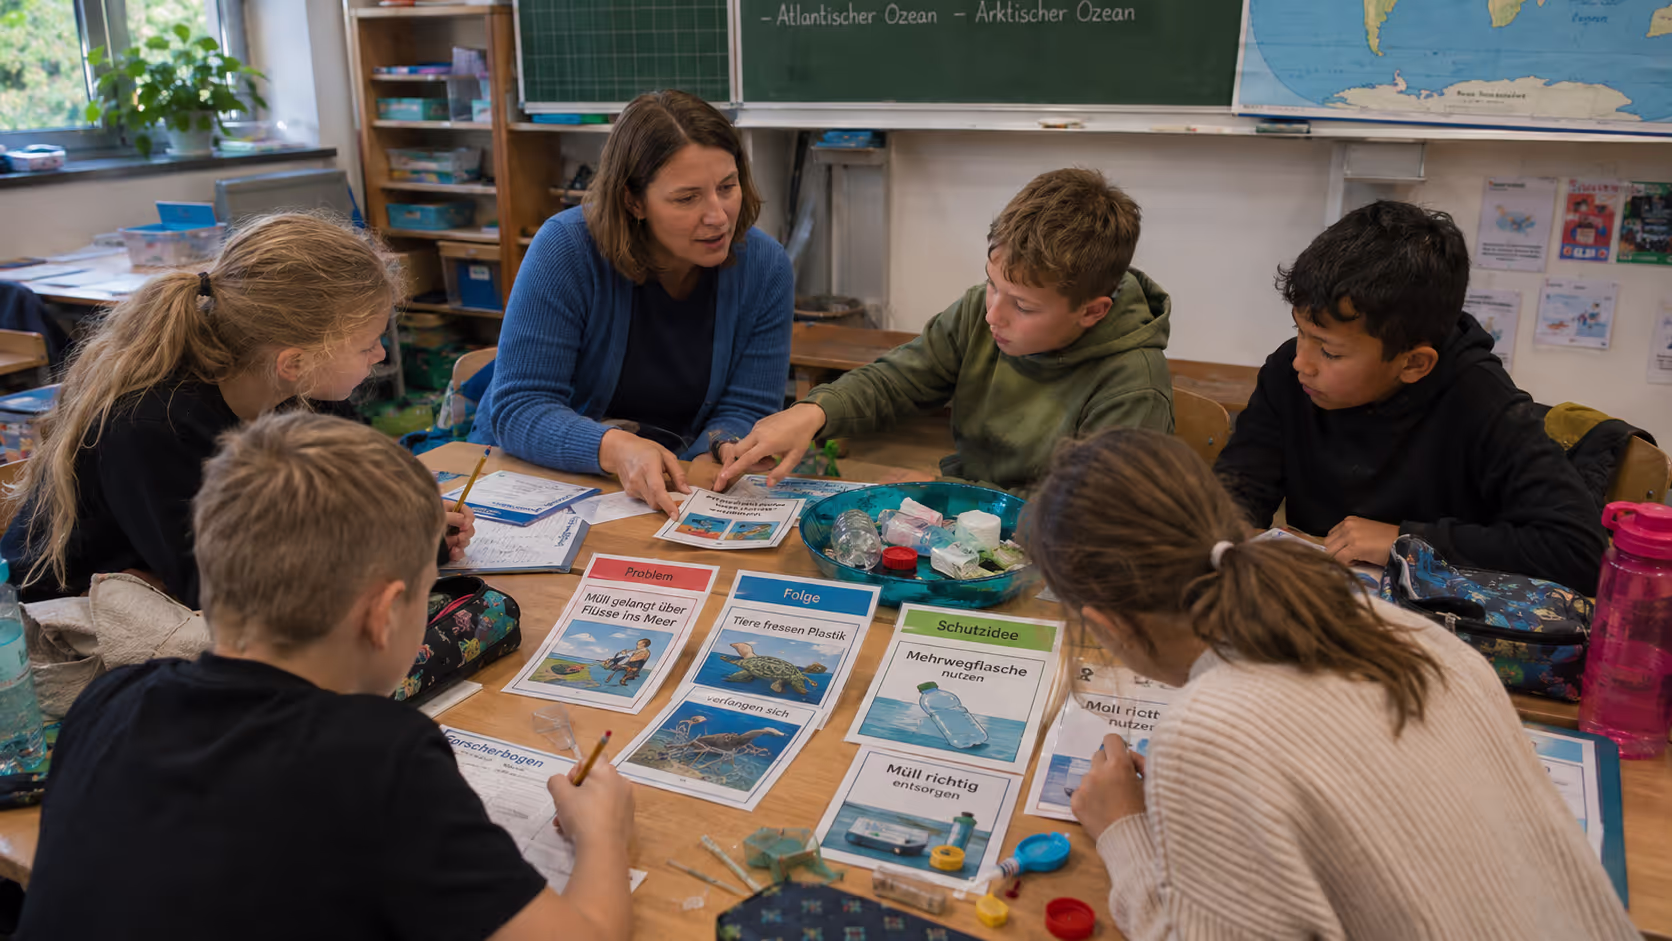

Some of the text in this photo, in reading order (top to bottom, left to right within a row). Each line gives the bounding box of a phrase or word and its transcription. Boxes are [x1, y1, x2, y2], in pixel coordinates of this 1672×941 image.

[776, 3, 876, 26] Atlantischer
[885, 3, 938, 25] Ozean
[975, 0, 1068, 23] Arktischer
[1077, 0, 1135, 22] Ozean
[625, 566, 674, 581] Problem
[584, 593, 688, 615] Müll gelangt über
[783, 588, 821, 604] Folge
[581, 605, 678, 627] Flüsse ins Meer
[733, 616, 847, 641] Tiere fressen Plastik
[936, 620, 1019, 641] Schutzidee
[906, 650, 1028, 677] Mehrwegflasche
[941, 670, 985, 682] nutzen
[765, 707, 790, 718] sich
[447, 734, 544, 768] Forscherbogen
[886, 763, 979, 793] Müll richtig
[892, 780, 960, 800] entsorgen
